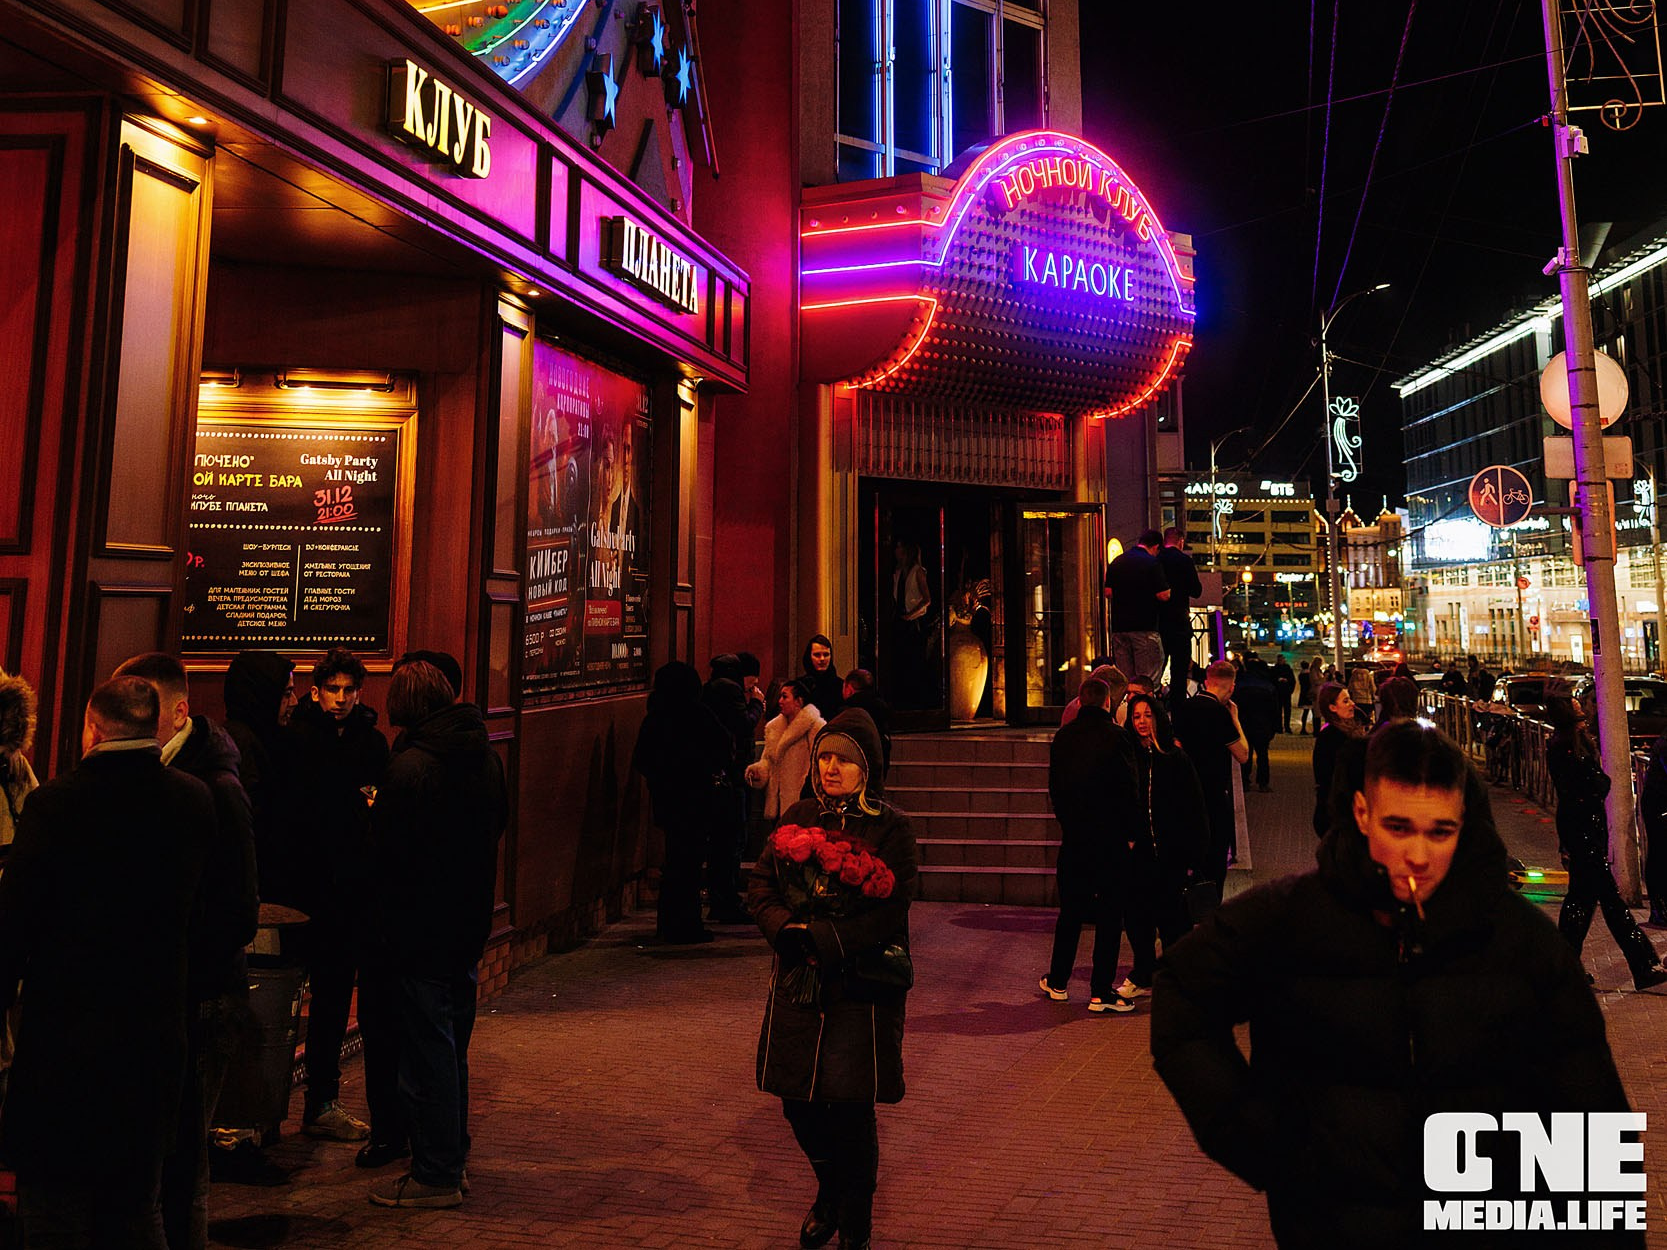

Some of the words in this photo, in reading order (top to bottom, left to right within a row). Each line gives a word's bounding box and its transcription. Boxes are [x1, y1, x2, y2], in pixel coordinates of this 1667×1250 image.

[403, 59, 491, 179] КЛУБ
[622, 217, 698, 314] ПЛАНЕТА
[1001, 155, 1092, 208] НОЧНОЙ
[1100, 169, 1153, 242] КЛУБ
[1023, 246, 1135, 301] КАРАОКЕ
[300, 453, 341, 468] Gatsby
[344, 455, 379, 469] Party
[219, 474, 263, 487] КАРТЕ
[269, 475, 303, 488] БАРА
[325, 470, 342, 482] All
[344, 470, 377, 485] Night
[313, 485, 353, 507] 31.12
[1270, 483, 1295, 496] ВТБ
[226, 502, 268, 512] ПЛАНЕТА
[317, 503, 354, 520] 21:00
[528, 578, 552, 601] НОВЫЙ
